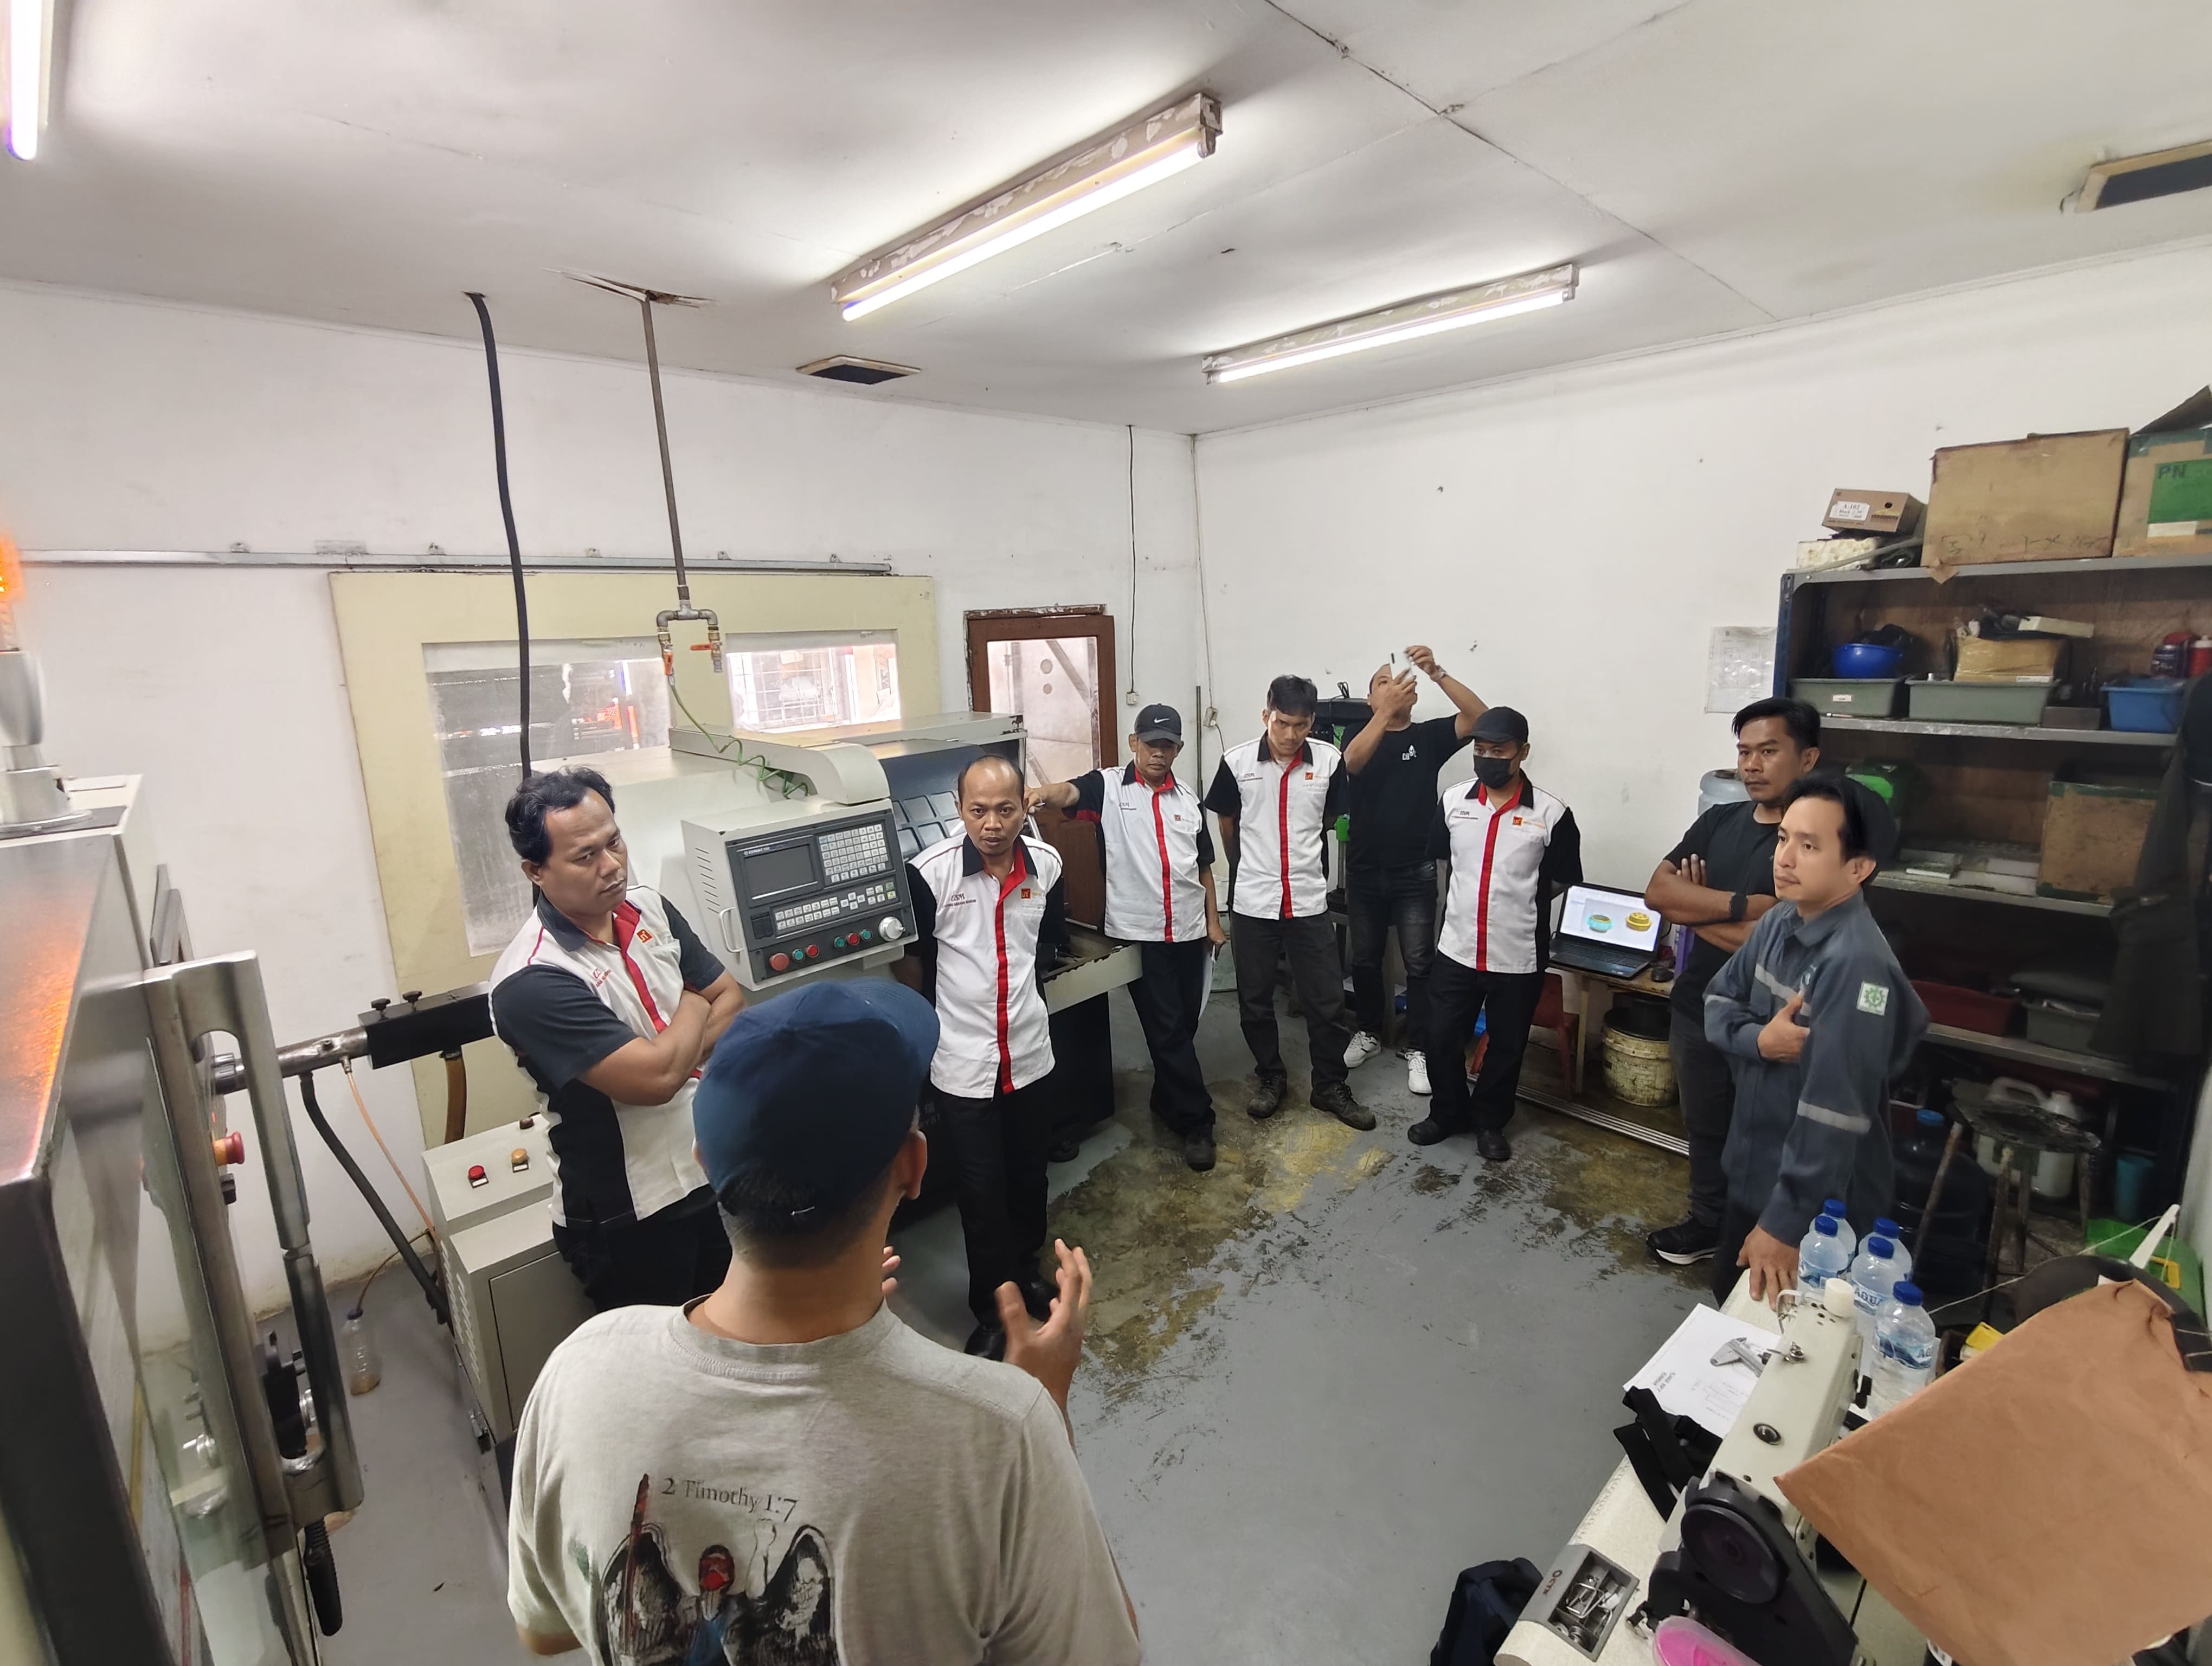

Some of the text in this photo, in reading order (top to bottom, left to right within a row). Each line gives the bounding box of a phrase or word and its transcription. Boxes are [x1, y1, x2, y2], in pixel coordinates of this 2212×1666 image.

[661, 1477, 800, 1523] 2 Timothy 1:7
